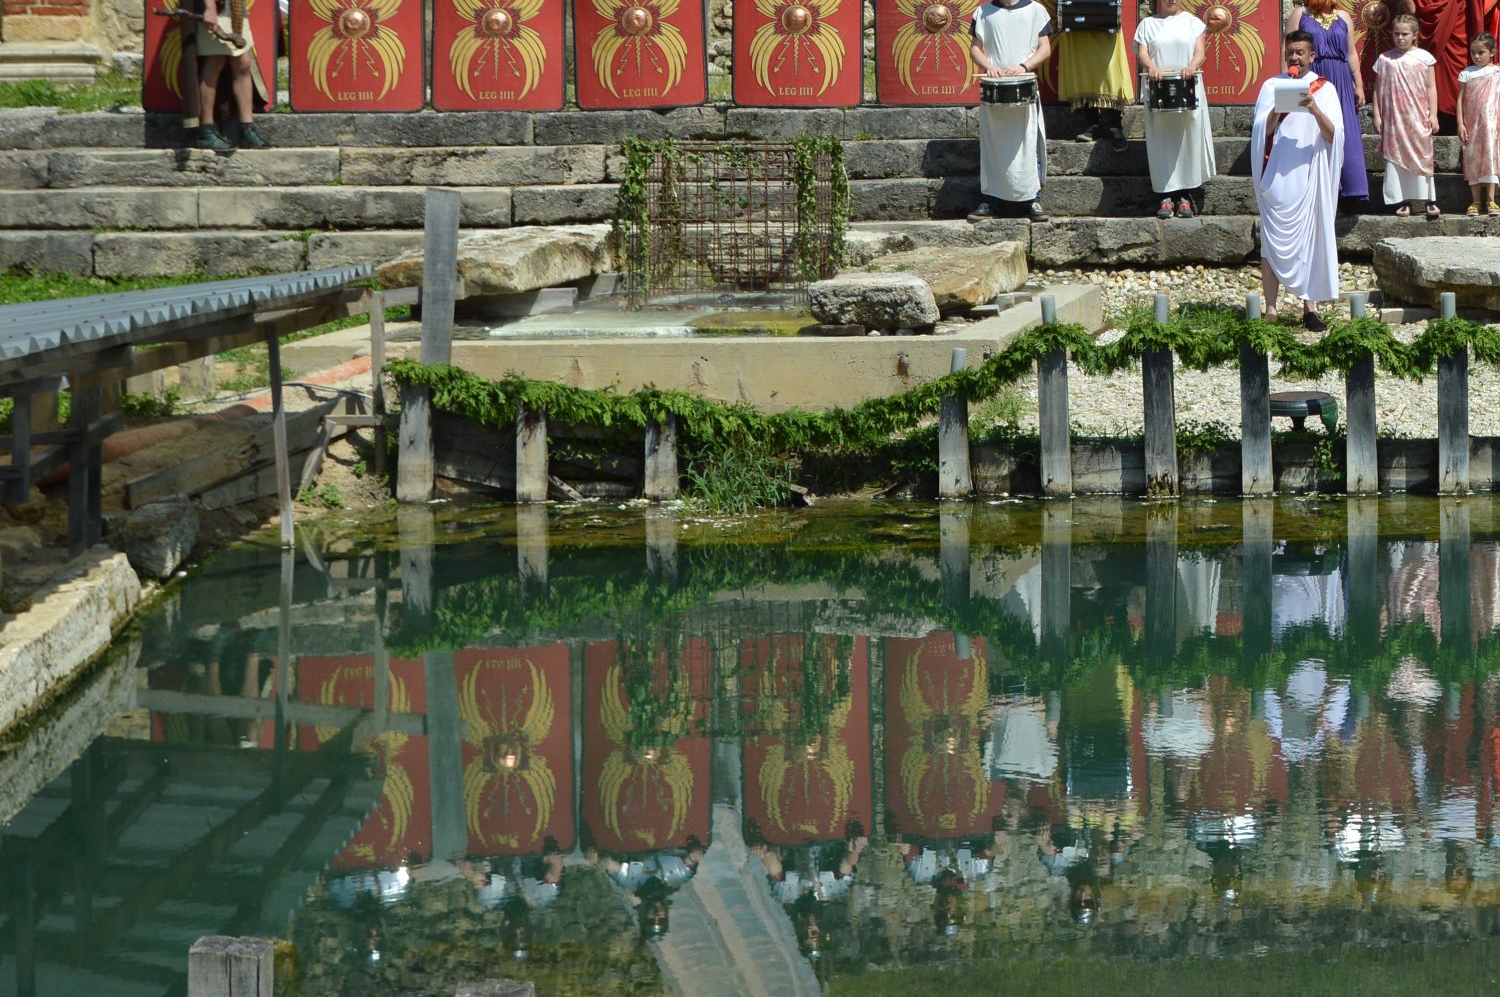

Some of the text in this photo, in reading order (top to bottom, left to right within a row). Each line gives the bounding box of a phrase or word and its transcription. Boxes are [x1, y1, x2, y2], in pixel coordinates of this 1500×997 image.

[479, 90, 515, 100] LEG IIII
[623, 87, 658, 98] LEG IIII
[779, 87, 814, 96] LEG IIII
[921, 85, 956, 95] LEG IIII
[1207, 85, 1235, 95] EG IIII
[337, 91, 374, 101] LEG IIII
